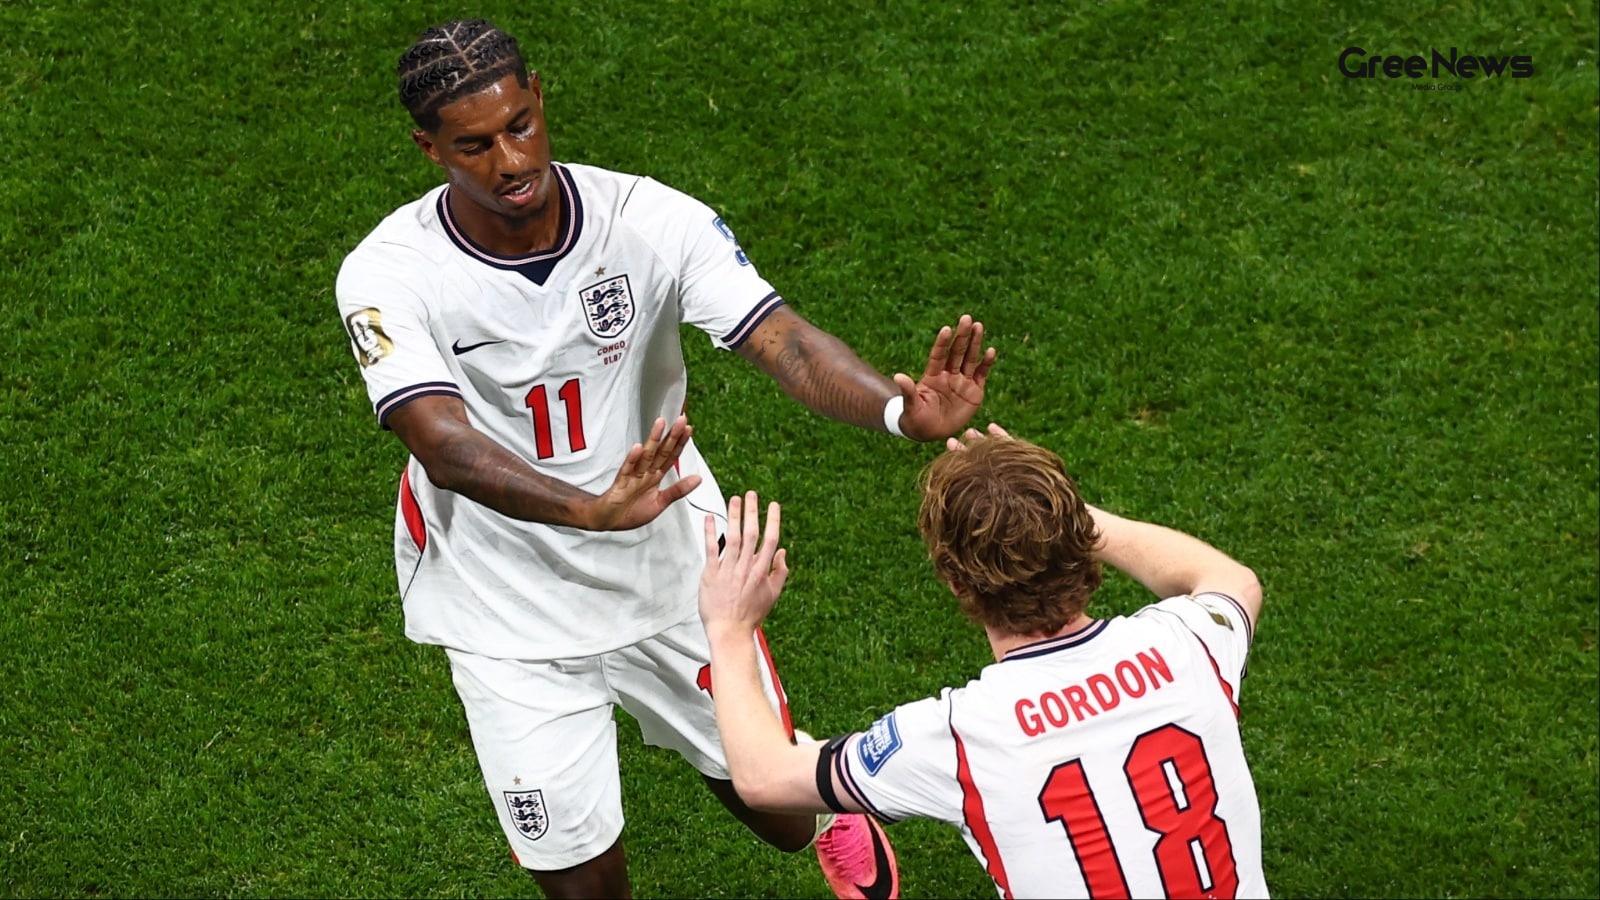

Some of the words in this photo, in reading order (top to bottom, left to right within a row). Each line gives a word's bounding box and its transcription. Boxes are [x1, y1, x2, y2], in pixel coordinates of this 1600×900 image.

[597, 340, 626, 356] CONGO
[524, 378, 587, 460] 11
[1014, 646, 1175, 737] GORDON
[1037, 722, 1240, 900] 18
